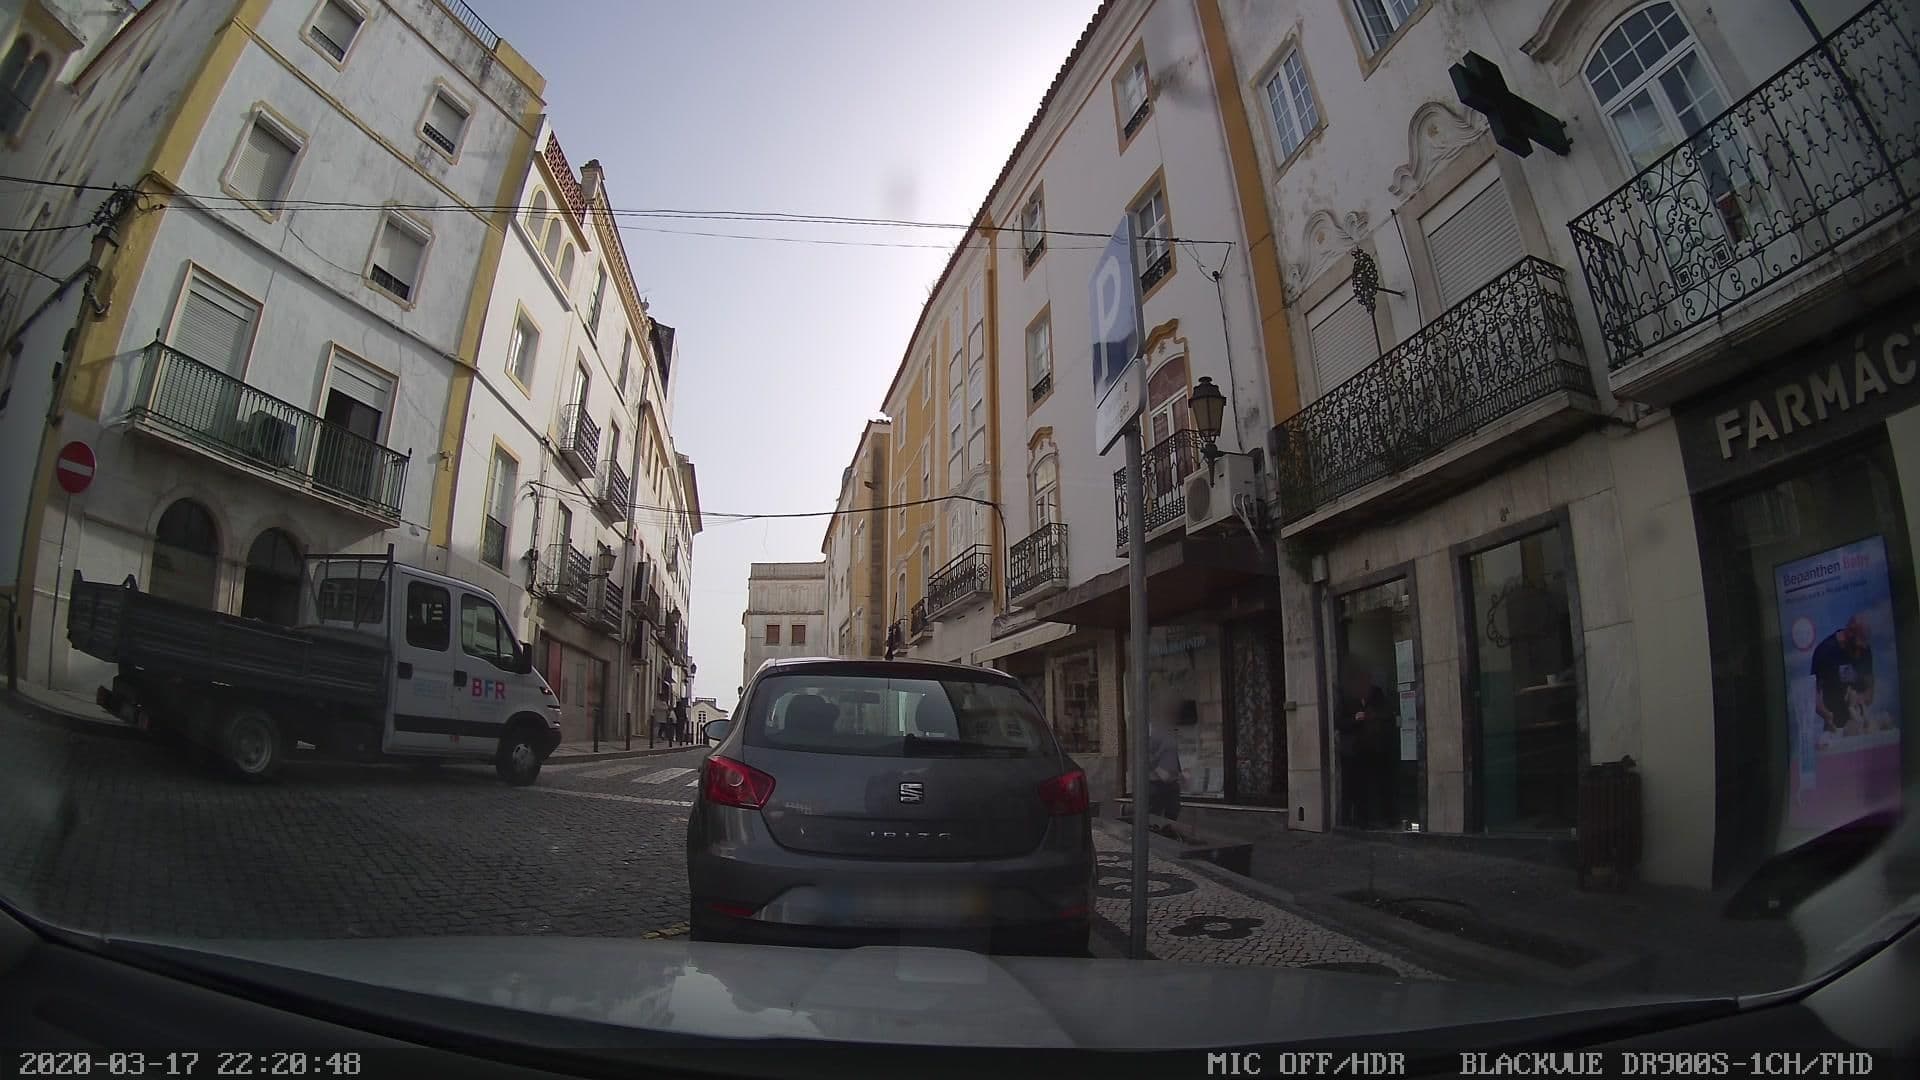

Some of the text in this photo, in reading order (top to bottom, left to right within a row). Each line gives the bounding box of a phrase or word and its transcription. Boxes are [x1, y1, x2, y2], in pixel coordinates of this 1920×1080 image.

[1096, 255, 1121, 380] P
[1715, 322, 1920, 460] FARMÁC
[1783, 561, 1841, 587] Bepanthen
[471, 678, 505, 700] BFR
